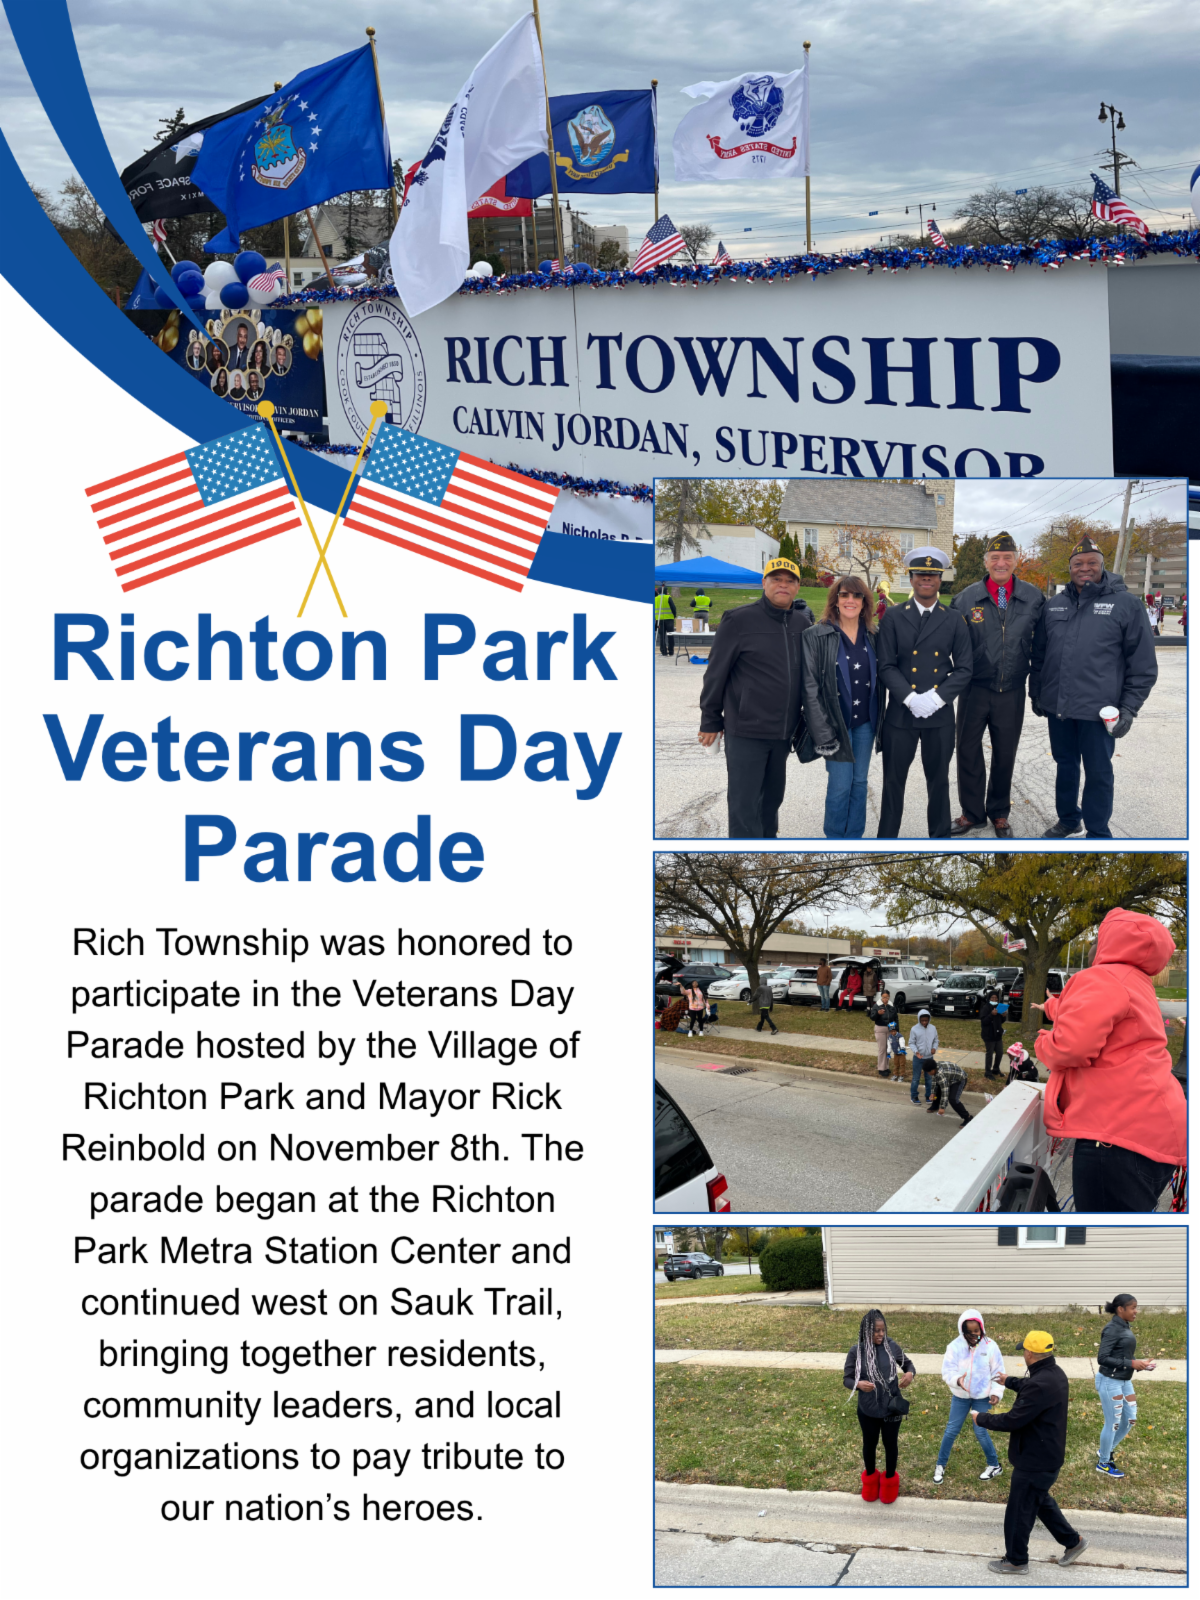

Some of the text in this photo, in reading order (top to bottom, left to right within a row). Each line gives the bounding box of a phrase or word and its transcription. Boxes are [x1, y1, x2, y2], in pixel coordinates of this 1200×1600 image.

[342, 302, 414, 343] RICH TOWNSHIP
[411, 370, 425, 425] ILLINOIS
[444, 331, 1061, 414] RICH TOWNSHIP
[288, 407, 319, 418] JORDAN
[339, 368, 375, 445] COOK COUNY
[452, 405, 1046, 478] CALVIN JORDAN, SUPERVISOR
[562, 521, 617, 541] Nicholas
